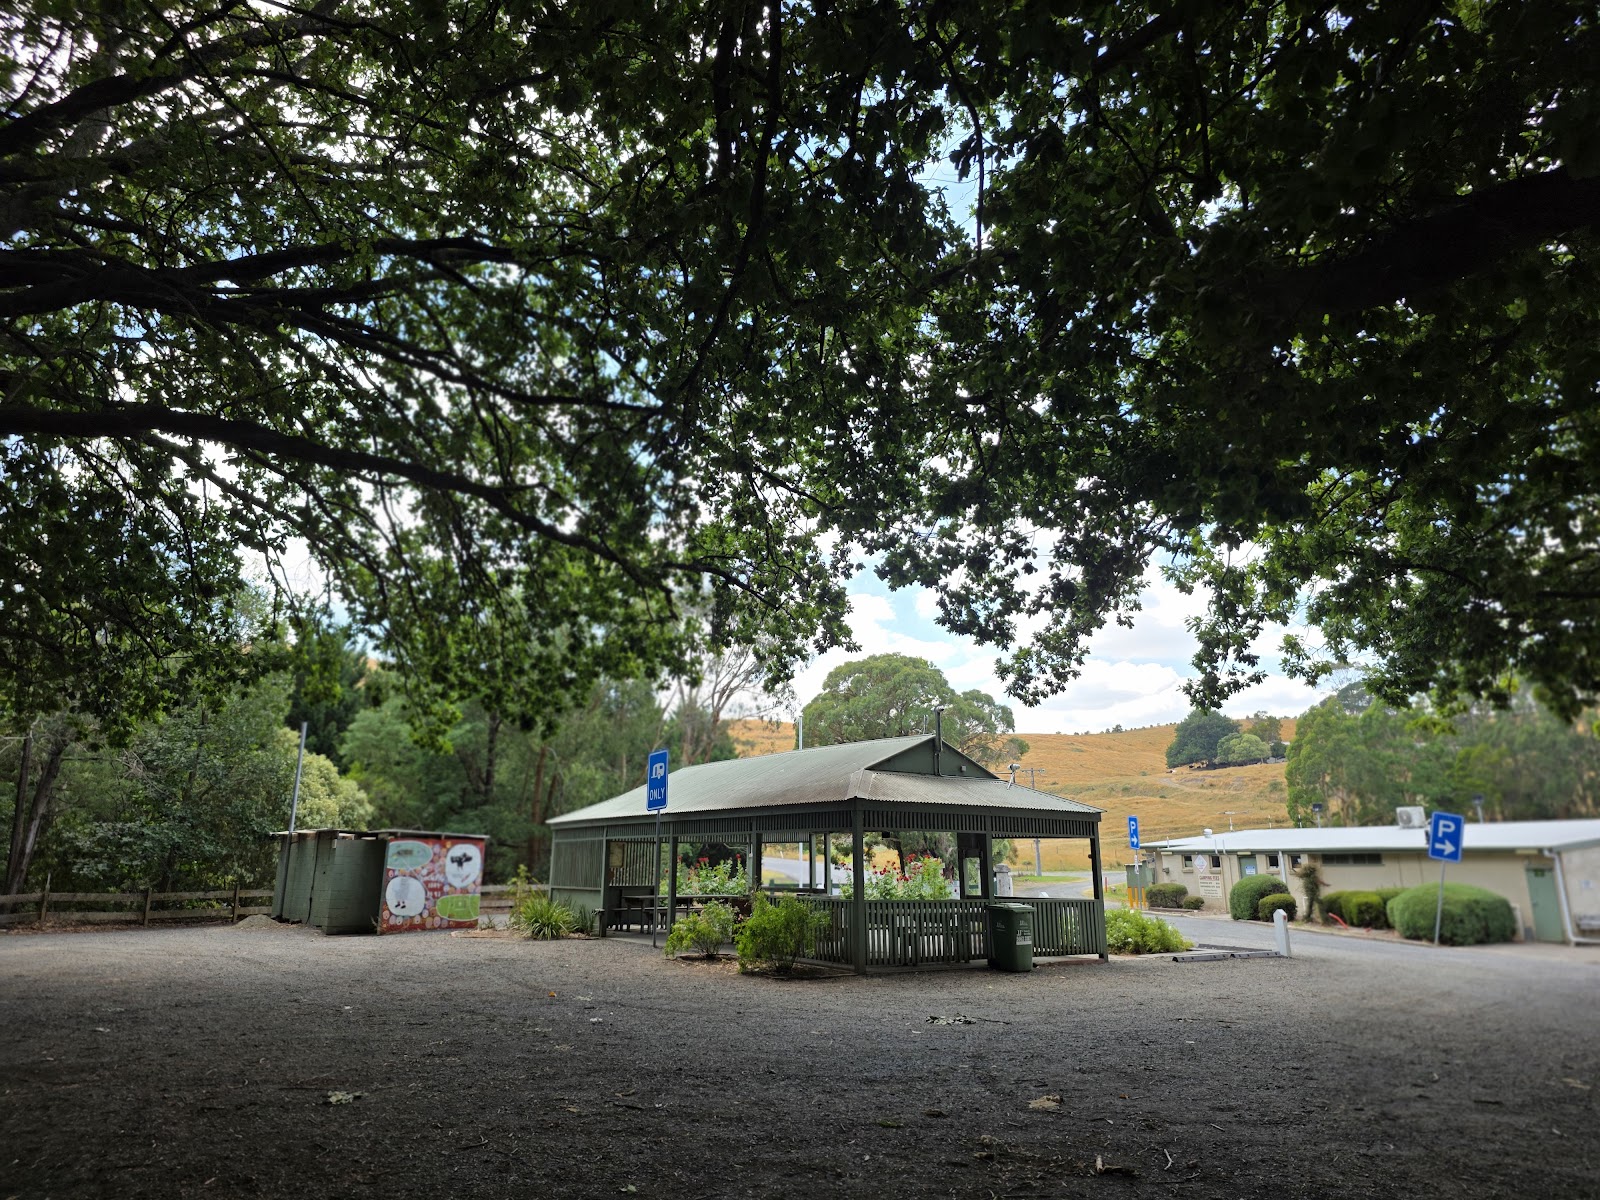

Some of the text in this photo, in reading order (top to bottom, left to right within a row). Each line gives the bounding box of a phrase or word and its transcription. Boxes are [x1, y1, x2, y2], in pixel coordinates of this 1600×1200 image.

[650, 787, 665, 801] ONLY
[1130, 821, 1136, 834] P
[1438, 819, 1456, 838] P
